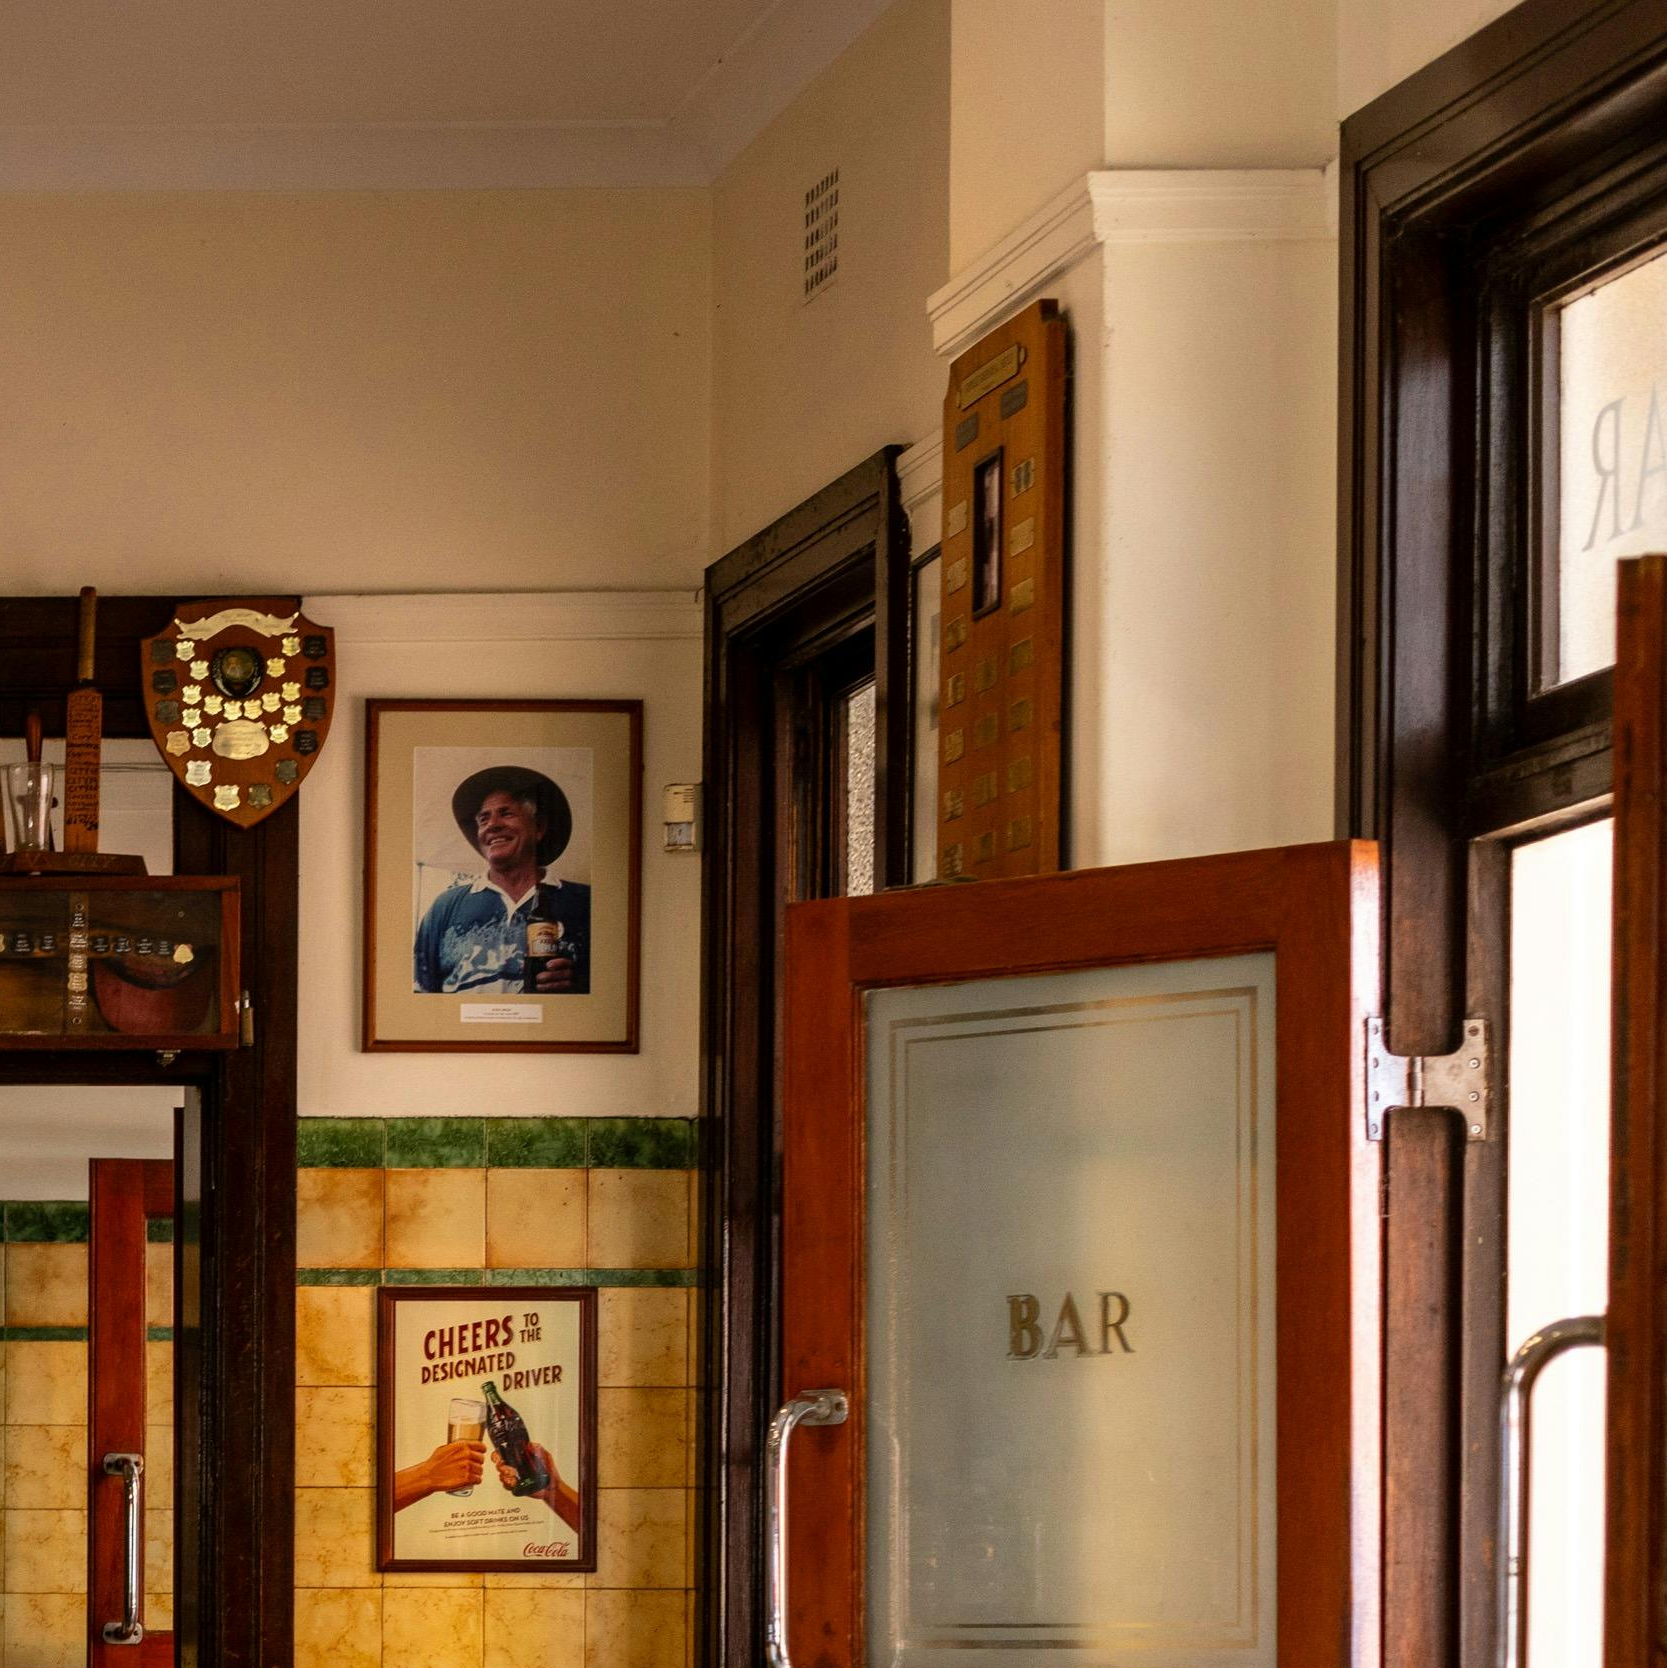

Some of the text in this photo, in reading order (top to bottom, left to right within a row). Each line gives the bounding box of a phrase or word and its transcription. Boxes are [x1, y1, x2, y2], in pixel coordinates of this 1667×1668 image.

[523, 1311, 539, 1327] TO
[1005, 1290, 1137, 1361] BAR
[424, 1315, 514, 1361] CHEERS
[519, 1326, 542, 1344] THE
[421, 1352, 516, 1385] DESIGNATED
[502, 1364, 563, 1392] DRIVER
[443, 1520, 465, 1528] ENJOY
[466, 1518, 484, 1526] SOFT
[484, 1516, 508, 1525] DRINKS
[466, 1510, 488, 1518] GOOD
[488, 1508, 505, 1516] MATE
